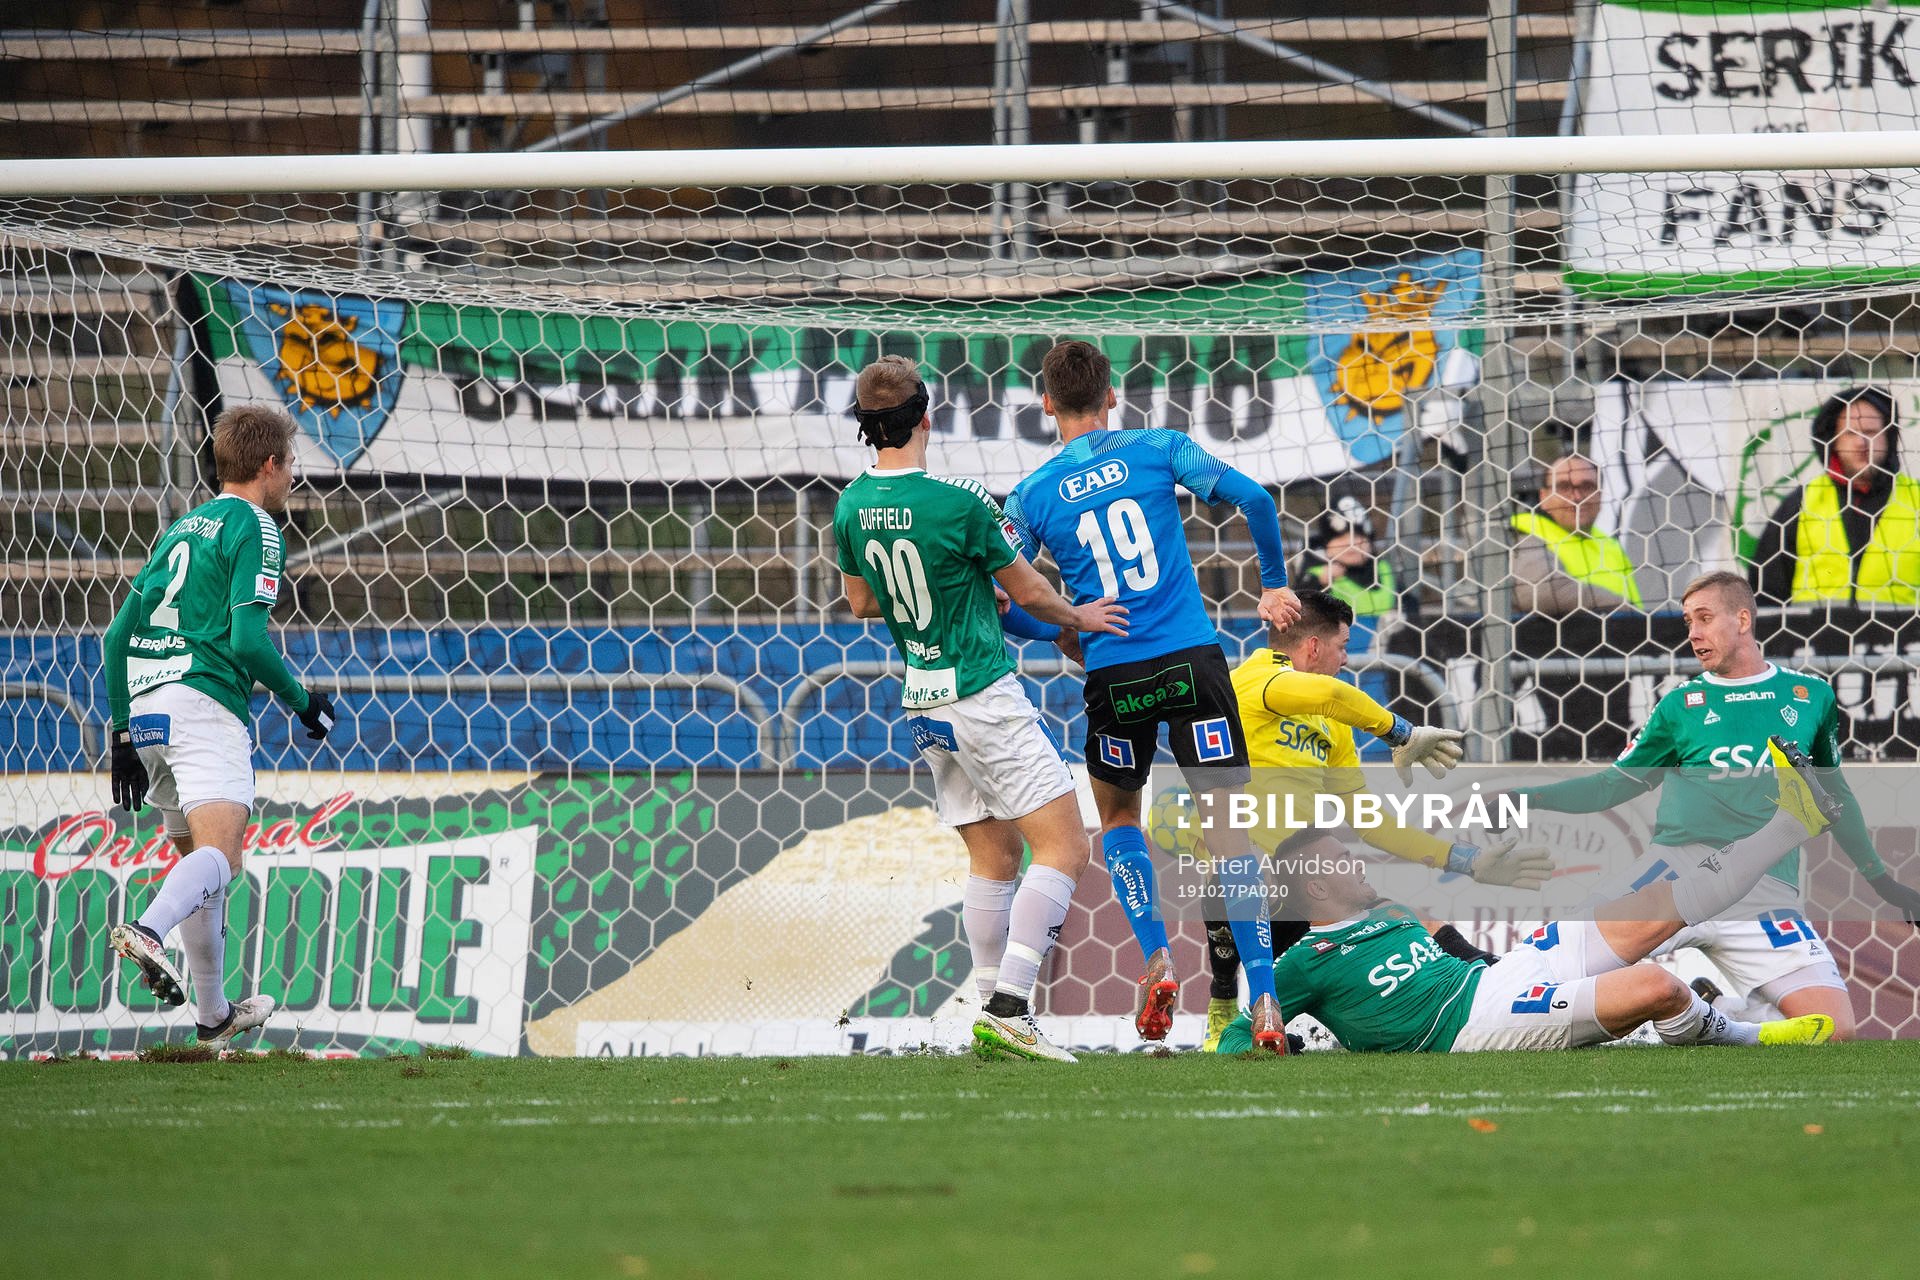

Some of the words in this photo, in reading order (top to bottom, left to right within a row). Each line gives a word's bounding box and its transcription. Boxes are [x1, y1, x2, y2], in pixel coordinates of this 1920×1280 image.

[1658, 176, 1890, 246] FANS
[1064, 463, 1124, 499] EAB
[858, 507, 913, 530] DUFFIELD
[1075, 498, 1160, 598] 19
[150, 540, 190, 632] 2
[864, 538, 935, 632] 20
[1115, 688, 1167, 714] akea
[1724, 690, 1776, 703] stadium
[1275, 721, 1332, 762] SSAB
[1707, 744, 1778, 780] SSA
[33, 790, 354, 884] Origal
